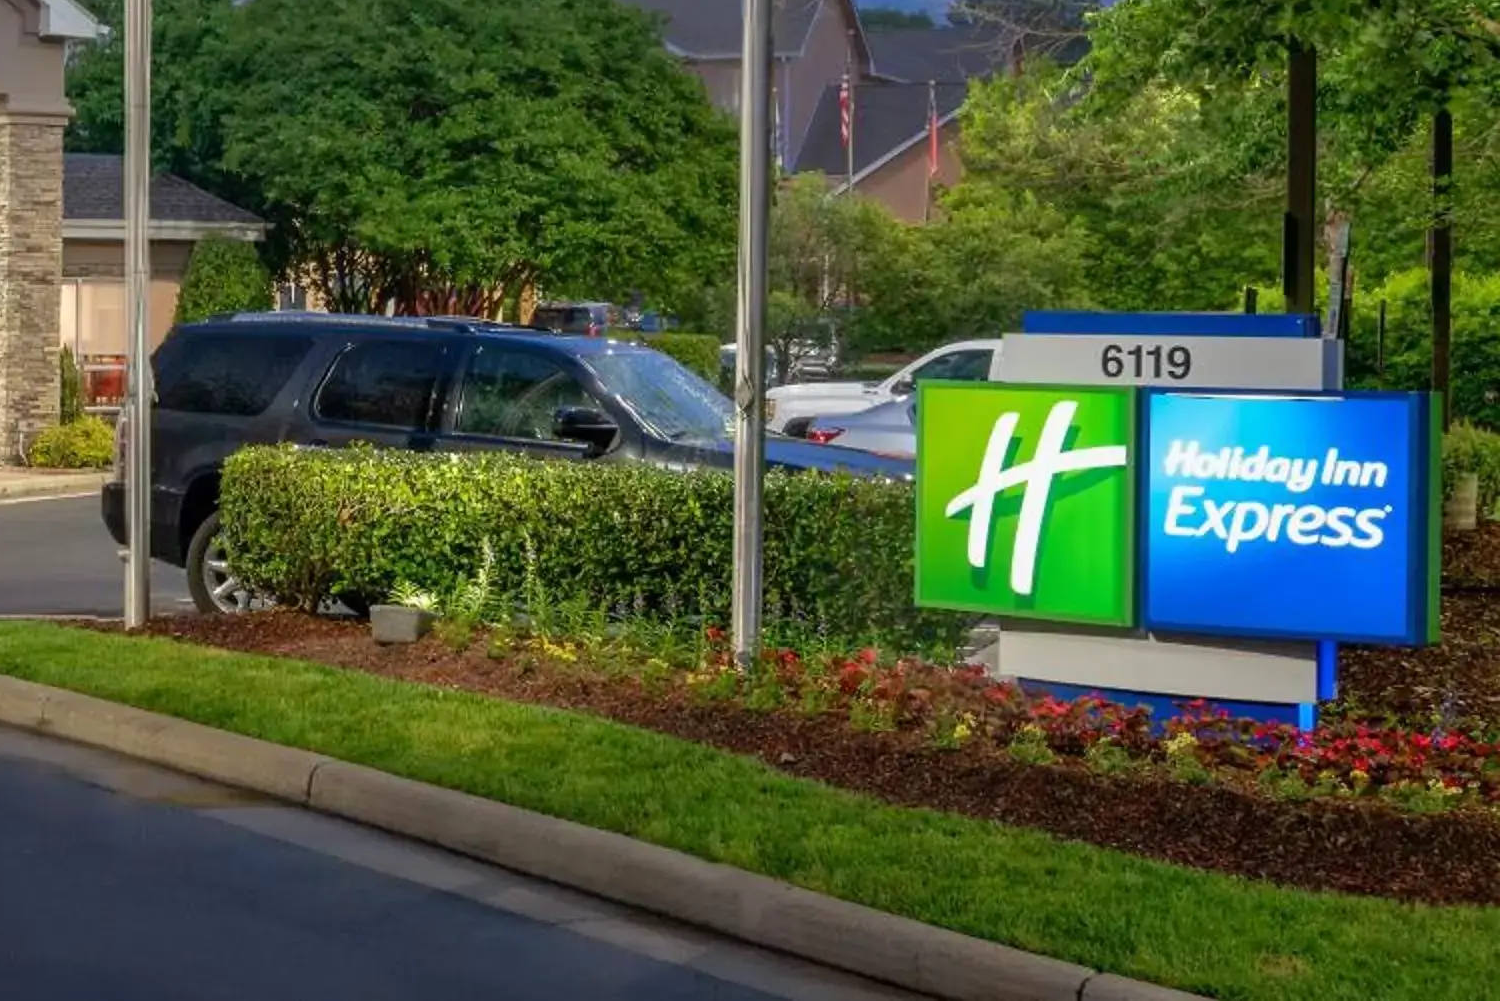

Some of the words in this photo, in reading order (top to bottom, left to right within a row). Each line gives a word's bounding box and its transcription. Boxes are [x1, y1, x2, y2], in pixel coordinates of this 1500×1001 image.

[1102, 344, 1191, 380] 6119
[1165, 440, 1319, 493] Holiday
[1320, 447, 1388, 488] Inn
[1163, 485, 1385, 553] Express
